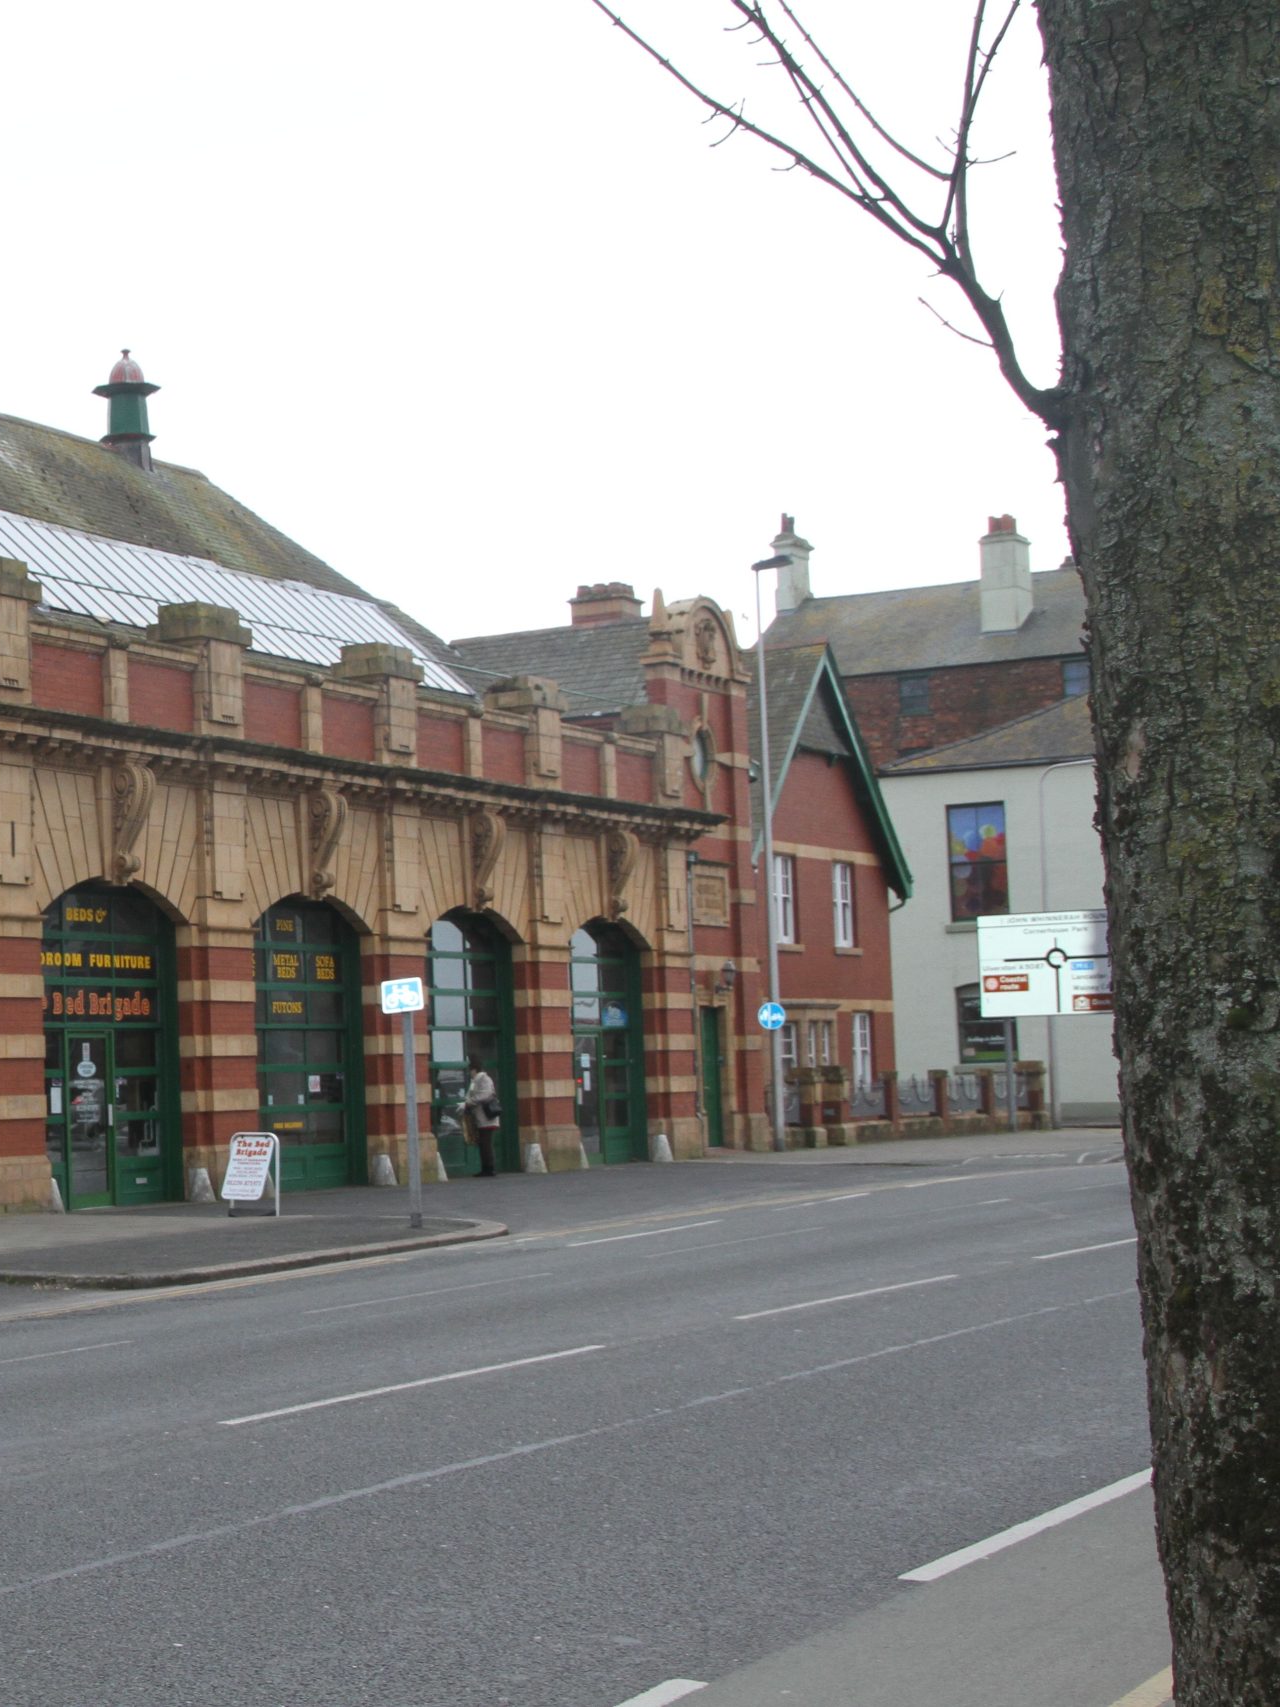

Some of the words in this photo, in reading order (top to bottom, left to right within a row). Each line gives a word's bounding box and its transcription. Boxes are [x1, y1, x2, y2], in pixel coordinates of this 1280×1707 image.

[65, 907, 94, 922] BEDS
[94, 907, 108, 924] &
[1007, 916, 1028, 924] JOHN
[275, 918, 294, 932] PINE
[1022, 927, 1069, 935] Cornerhouse
[1071, 925, 1089, 933] Park
[88, 953, 151, 969] FURNITURE
[272, 953, 299, 966] METAL
[315, 955, 335, 968] SOFA
[276, 966, 296, 979] BEDS
[316, 967, 336, 980] BEDS
[999, 975, 1027, 983] Coastal
[52, 989, 85, 1015] Bed
[88, 990, 151, 1021] Brigade
[271, 1001, 303, 1014] FUTONS
[236, 1148, 267, 1157] Brigade
